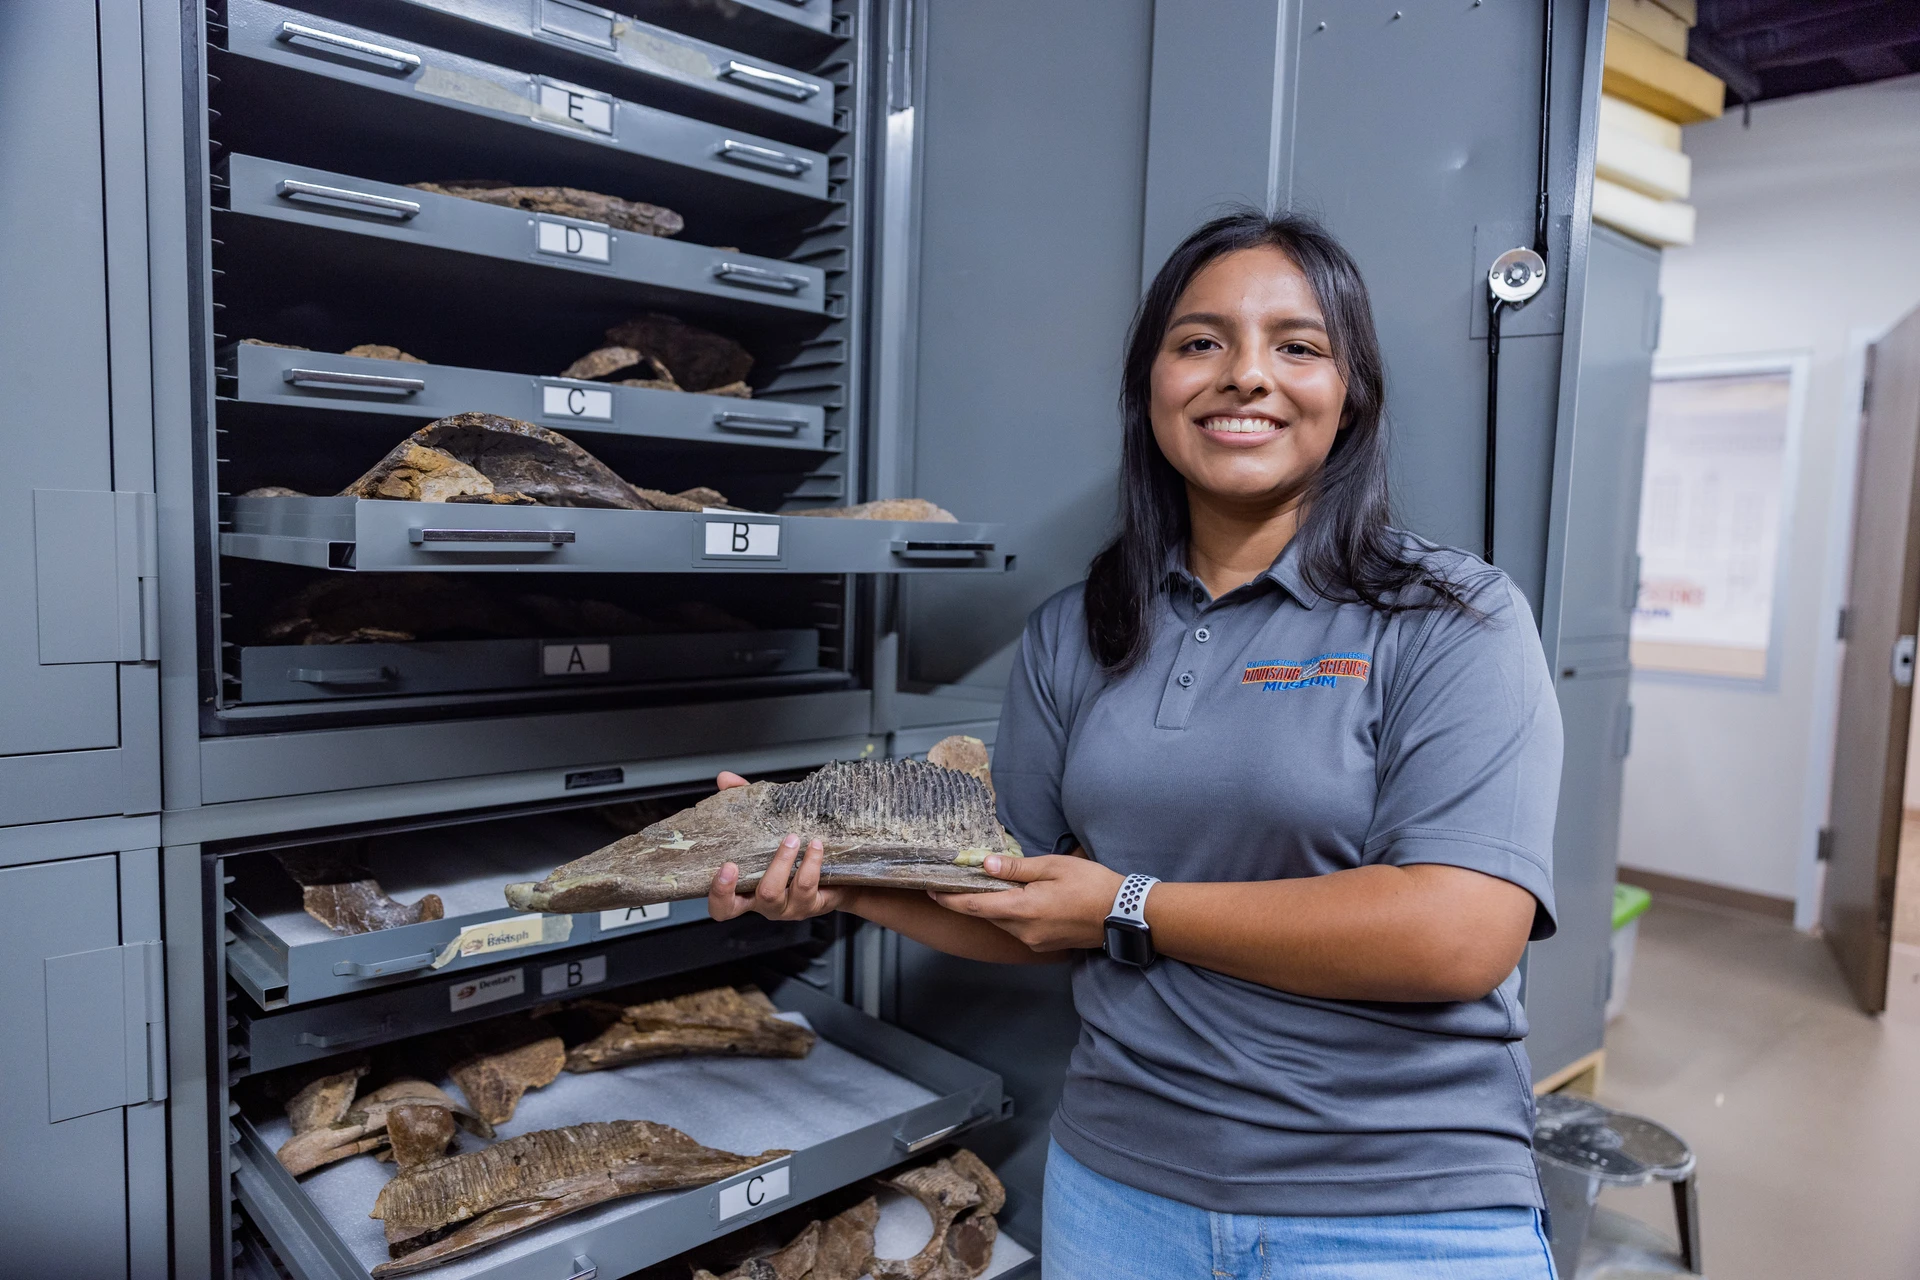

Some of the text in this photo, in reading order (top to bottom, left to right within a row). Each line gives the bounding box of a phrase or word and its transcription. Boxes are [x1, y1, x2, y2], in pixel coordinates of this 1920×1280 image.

[568, 91, 584, 123] E
[565, 225, 583, 254] D
[568, 387, 585, 415] C
[731, 522, 750, 553] B
[567, 644, 586, 672] A
[1318, 659, 1370, 679] SCIENCE
[1263, 676, 1338, 692] MUSEUM
[567, 962, 583, 988] B
[746, 1175, 765, 1207] C
